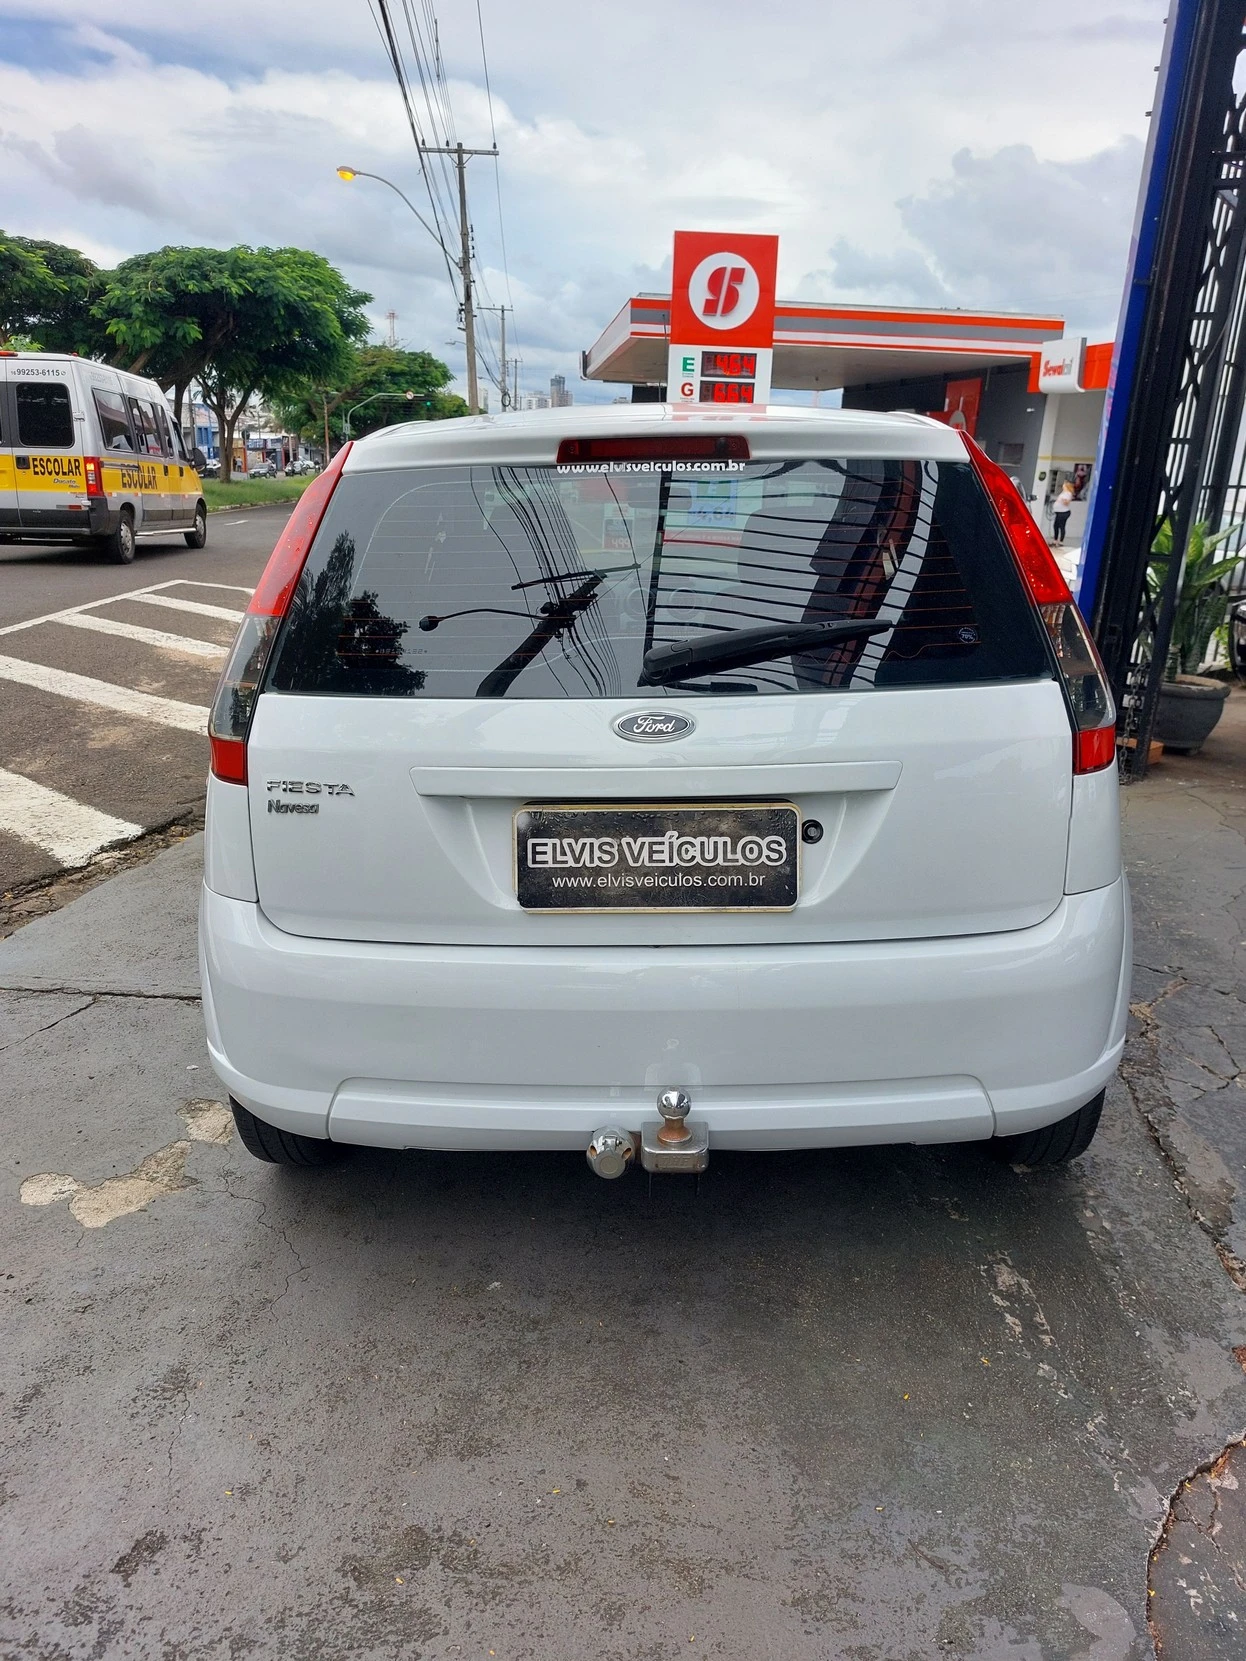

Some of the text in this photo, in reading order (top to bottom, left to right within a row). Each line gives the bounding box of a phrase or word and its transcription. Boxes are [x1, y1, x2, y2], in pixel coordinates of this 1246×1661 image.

[682, 356, 696, 373] E
[680, 382, 694, 397] G
[31, 457, 82, 477] ESCOLAR
[556, 459, 746, 474] www.elvisveiculos.com.br
[120, 463, 158, 490] ESCOLAR
[632, 715, 676, 733] Ford
[266, 780, 355, 797] FIESTA
[267, 799, 320, 814] Navesa
[527, 830, 787, 868] ELVIS VEÍCULOS
[552, 872, 766, 888] www.elvisveiculos.com.br
